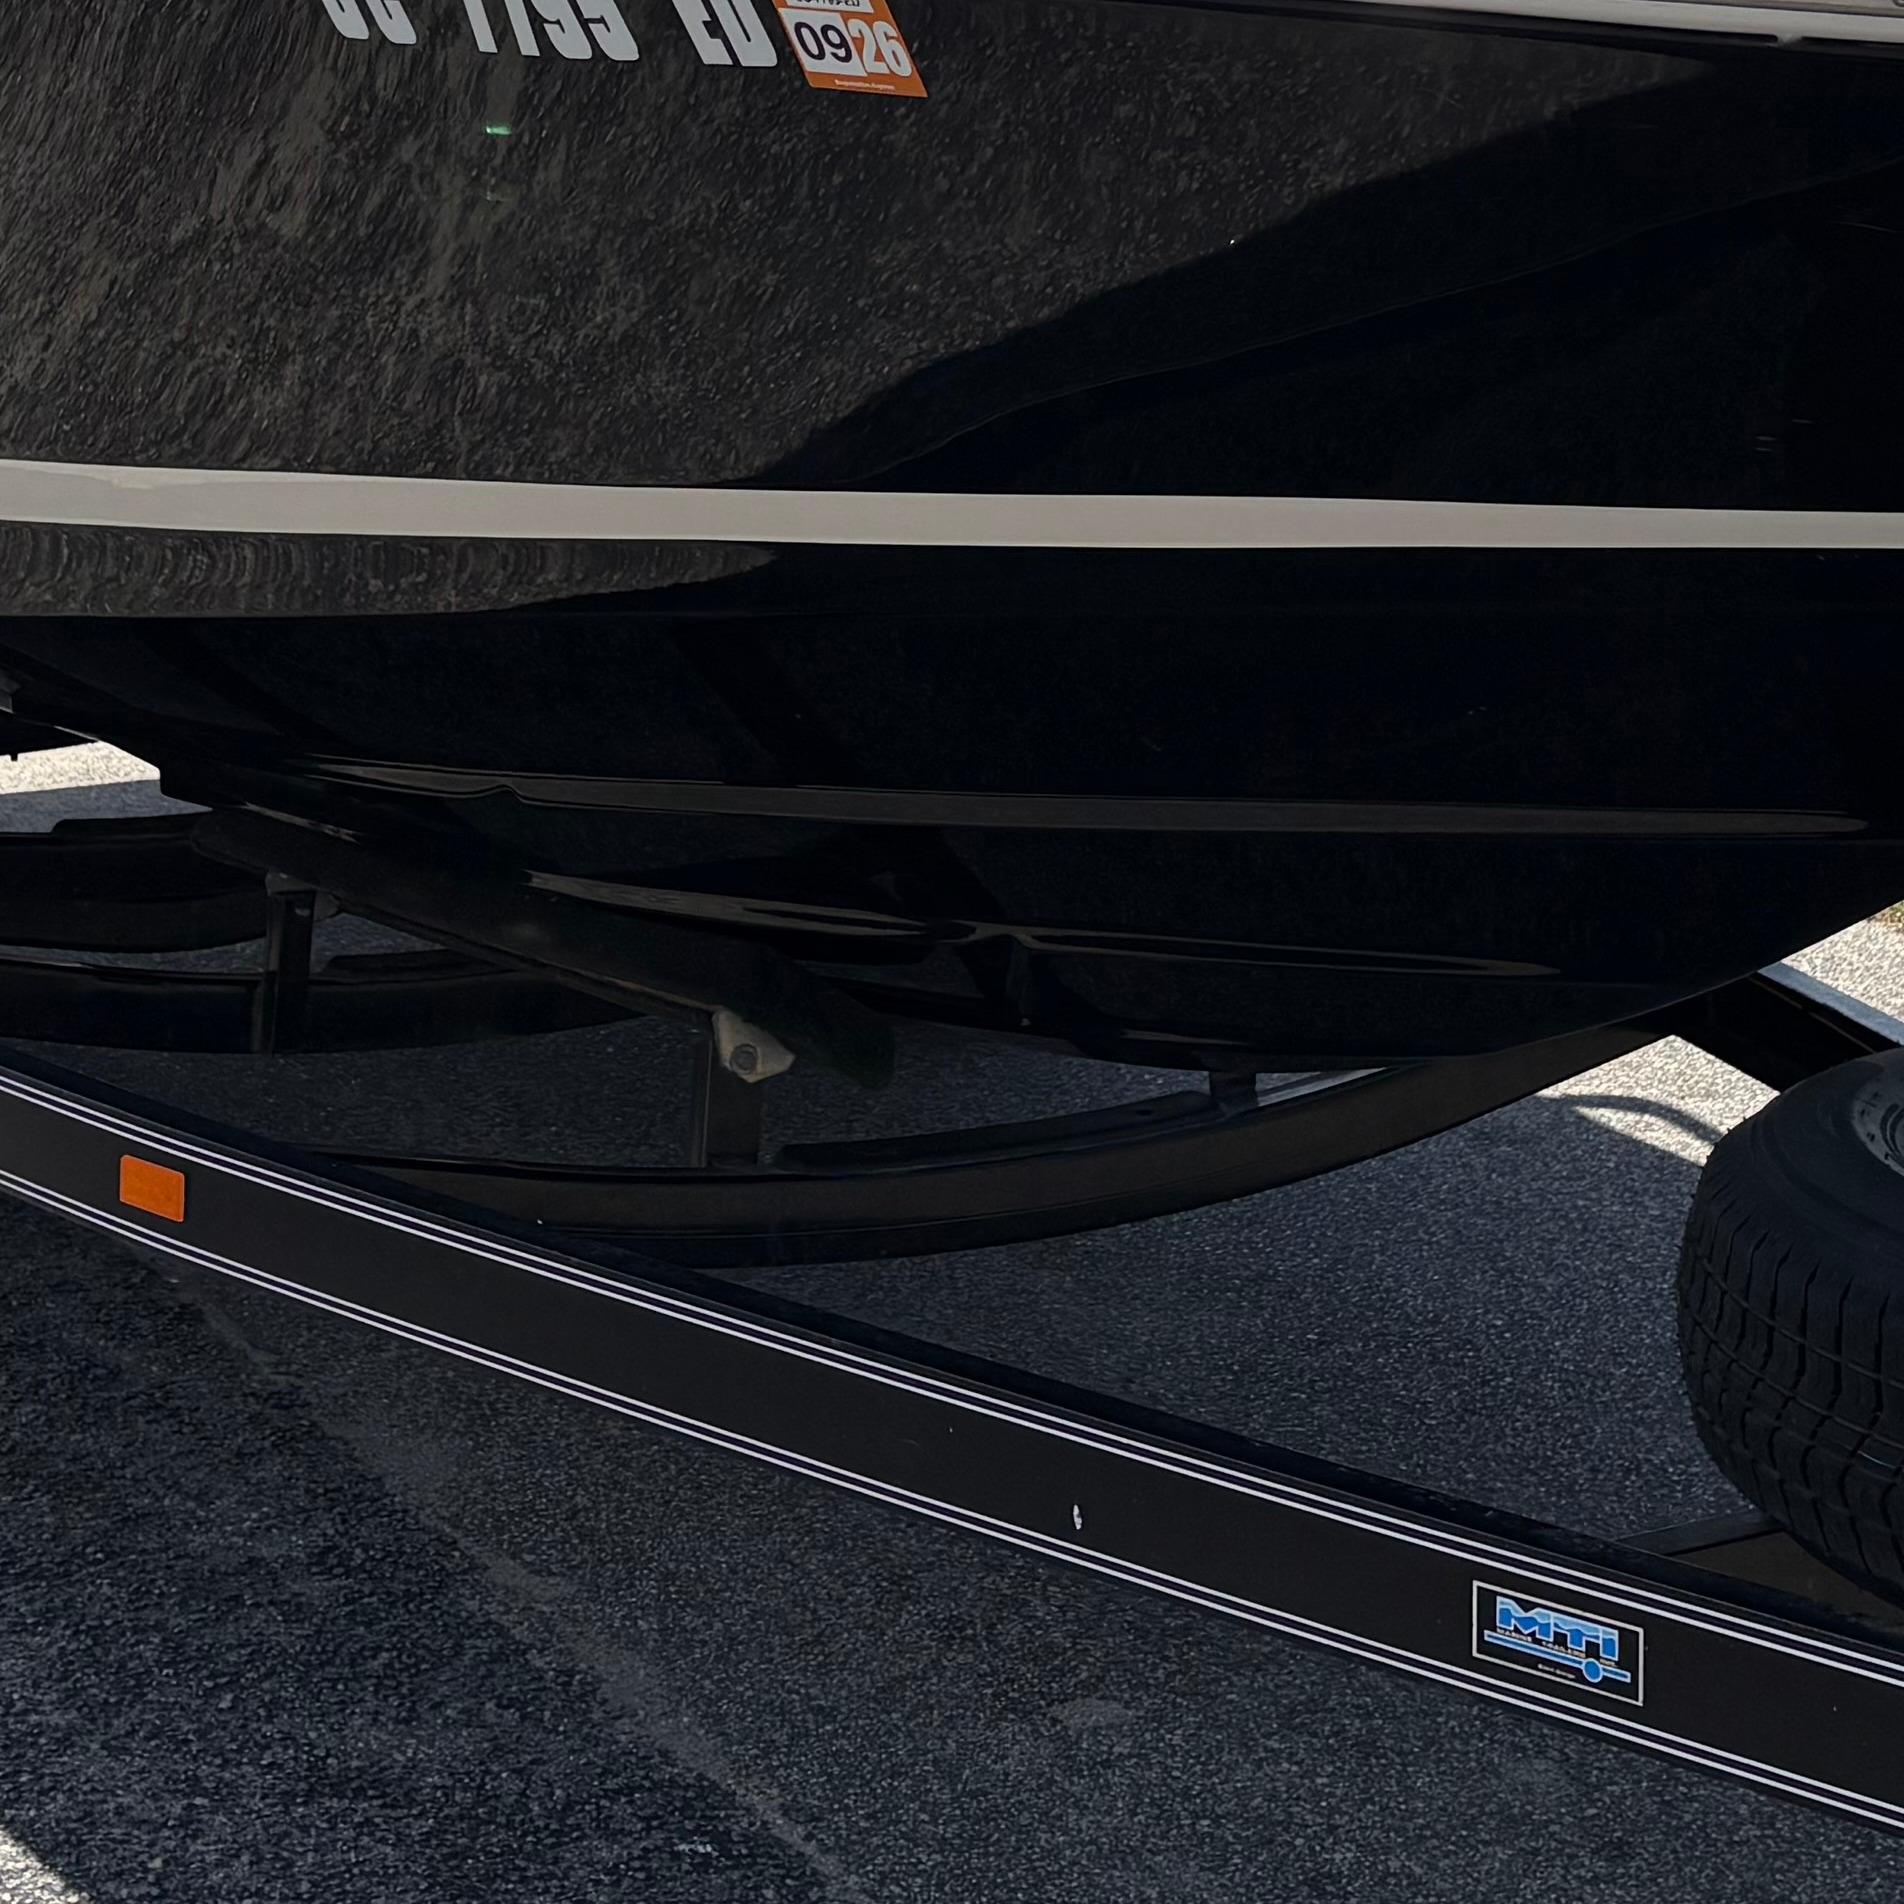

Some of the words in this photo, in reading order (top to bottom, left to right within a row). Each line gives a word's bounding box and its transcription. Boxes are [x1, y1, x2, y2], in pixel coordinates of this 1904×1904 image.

[793, 21, 853, 63] 09
[847, 18, 912, 77] 26
[1496, 1595, 1619, 1662] MTI
